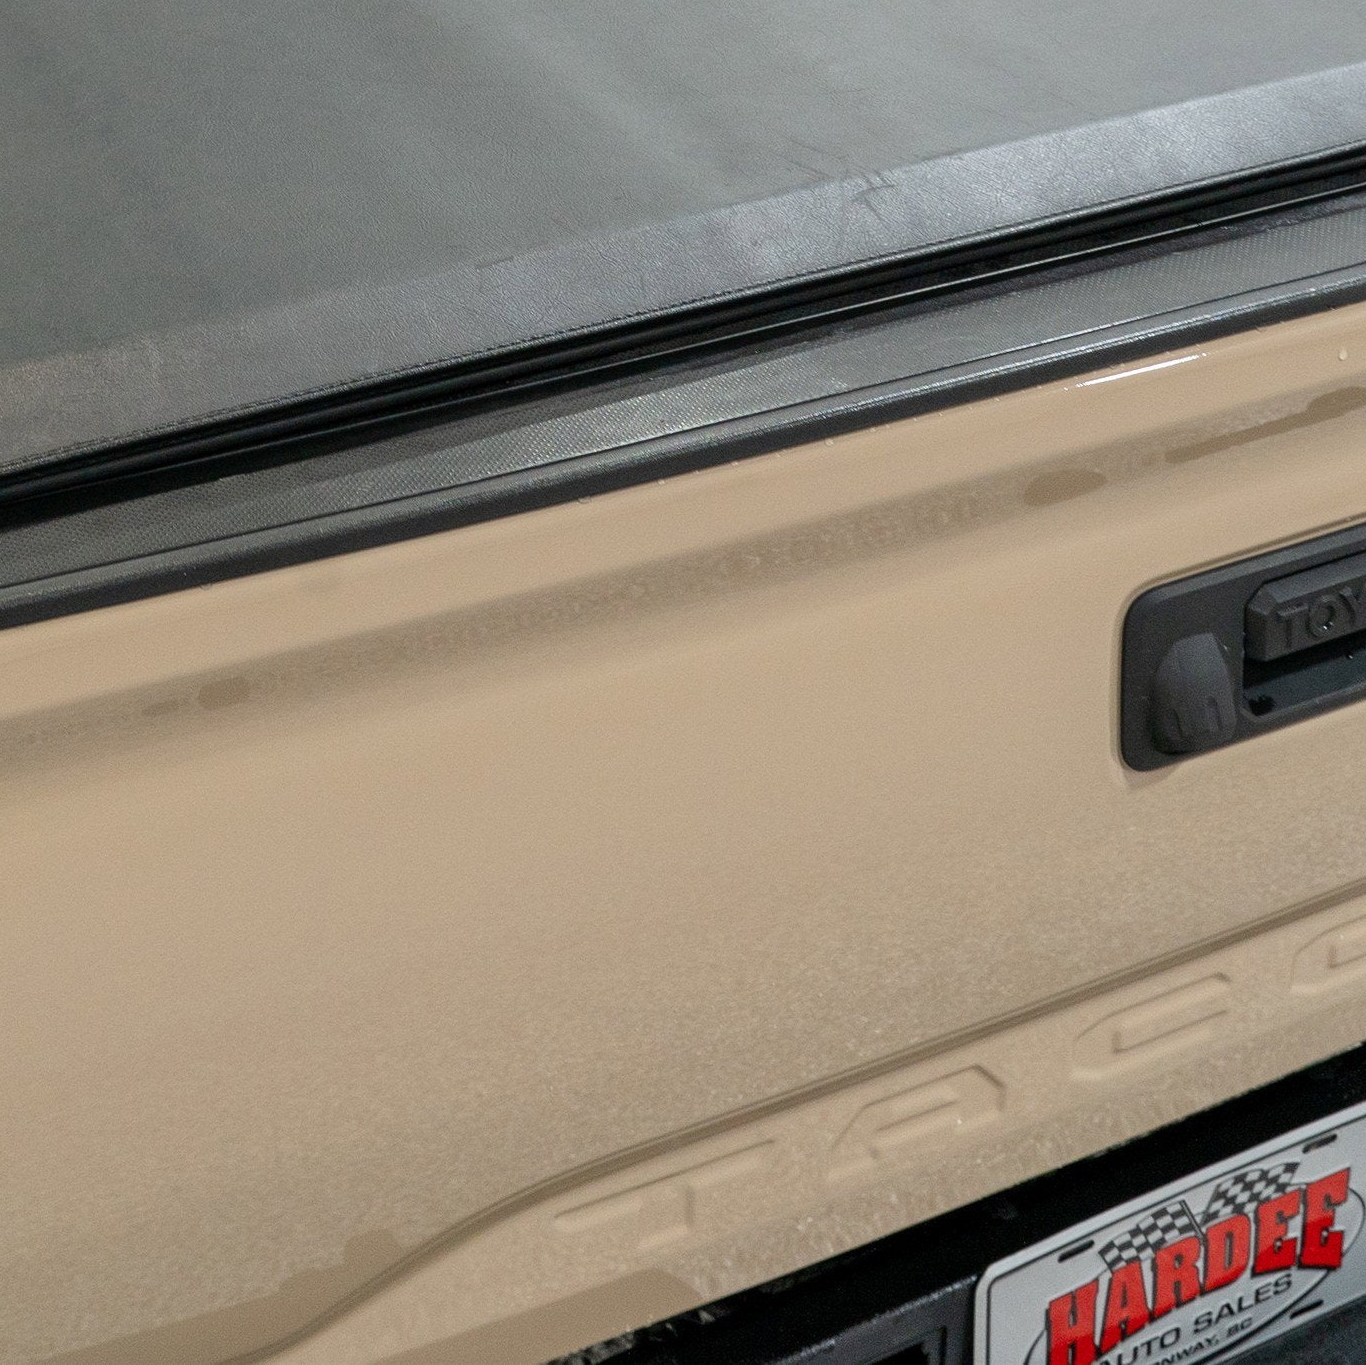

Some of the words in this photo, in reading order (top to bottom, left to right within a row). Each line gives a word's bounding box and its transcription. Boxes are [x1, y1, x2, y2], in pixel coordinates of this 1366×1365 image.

[1045, 1166, 1352, 1365] HARDEE
[1099, 1326, 1182, 1365] UTO
[1193, 1272, 1293, 1335] SALES
